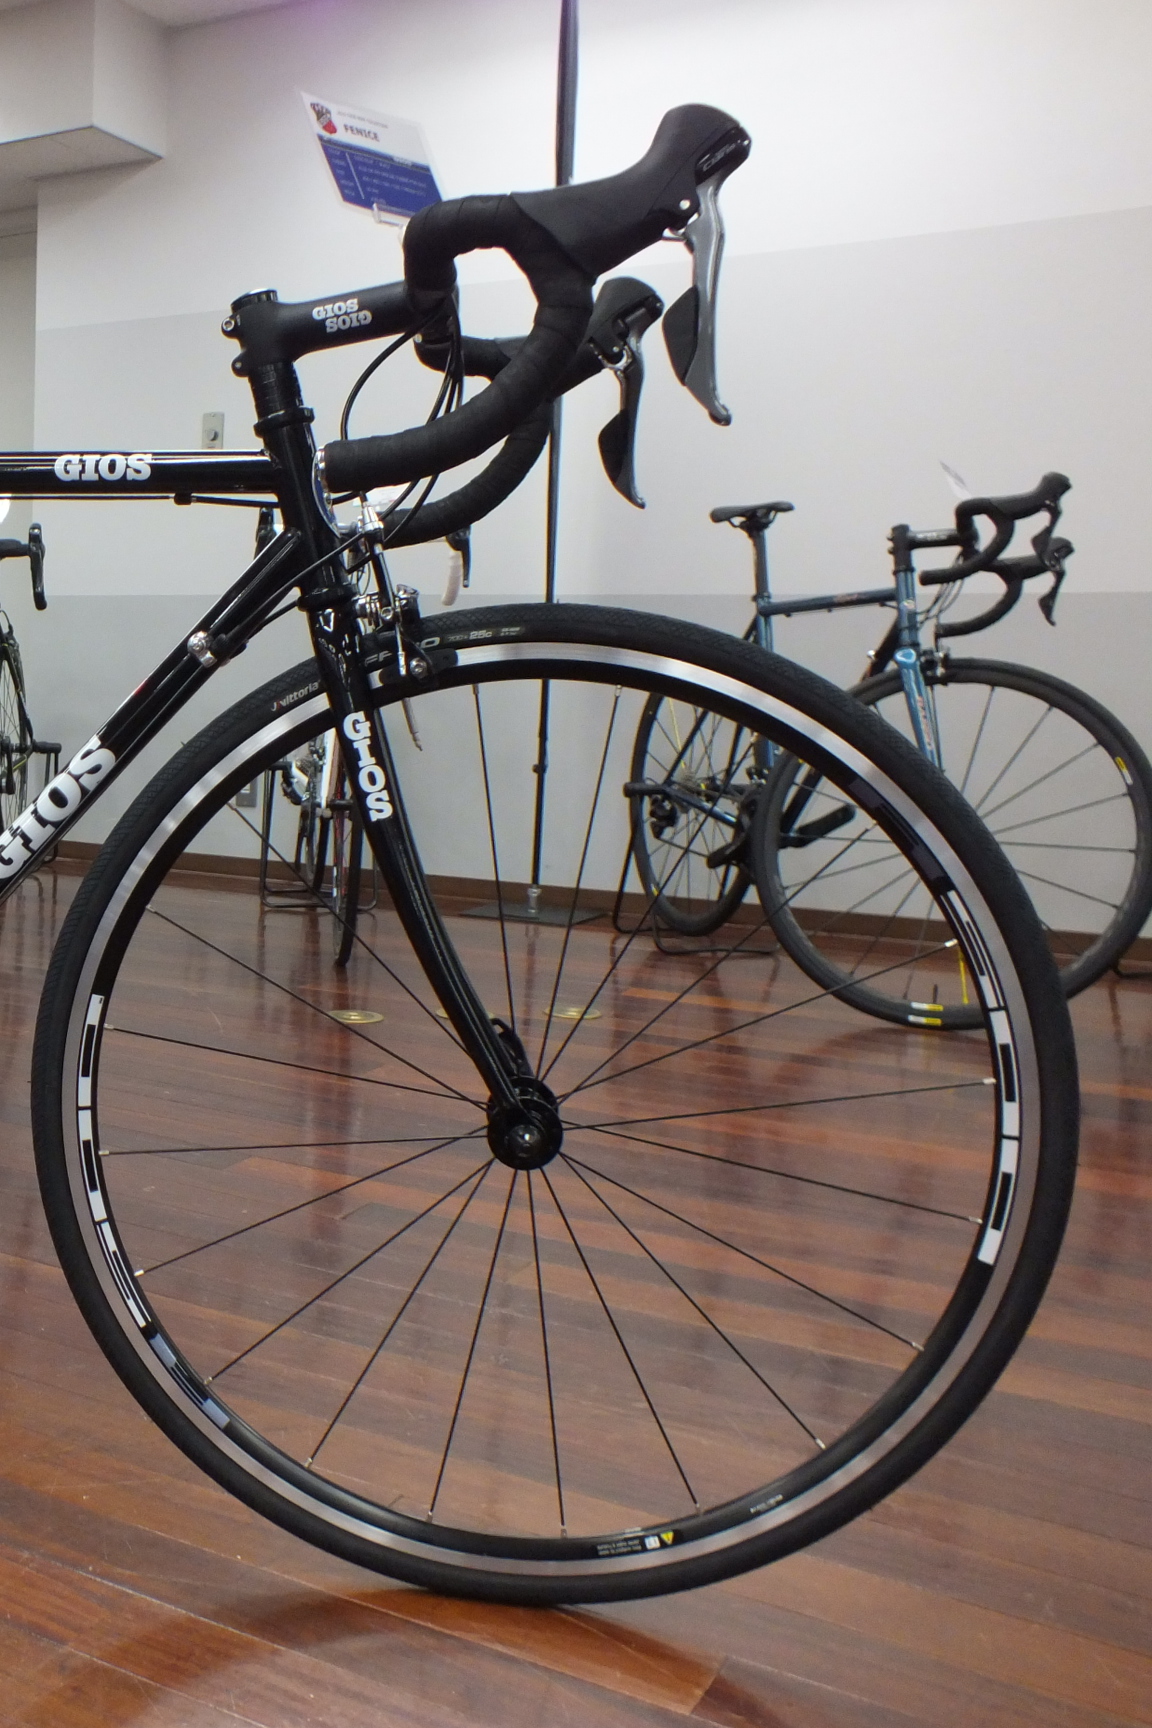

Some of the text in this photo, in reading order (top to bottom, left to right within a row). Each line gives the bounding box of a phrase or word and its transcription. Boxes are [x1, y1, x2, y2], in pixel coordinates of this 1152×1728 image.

[343, 123, 381, 143] FENICE
[312, 298, 359, 321] GIOS
[54, 453, 152, 482] GIOS
[343, 710, 394, 822] GIOS
